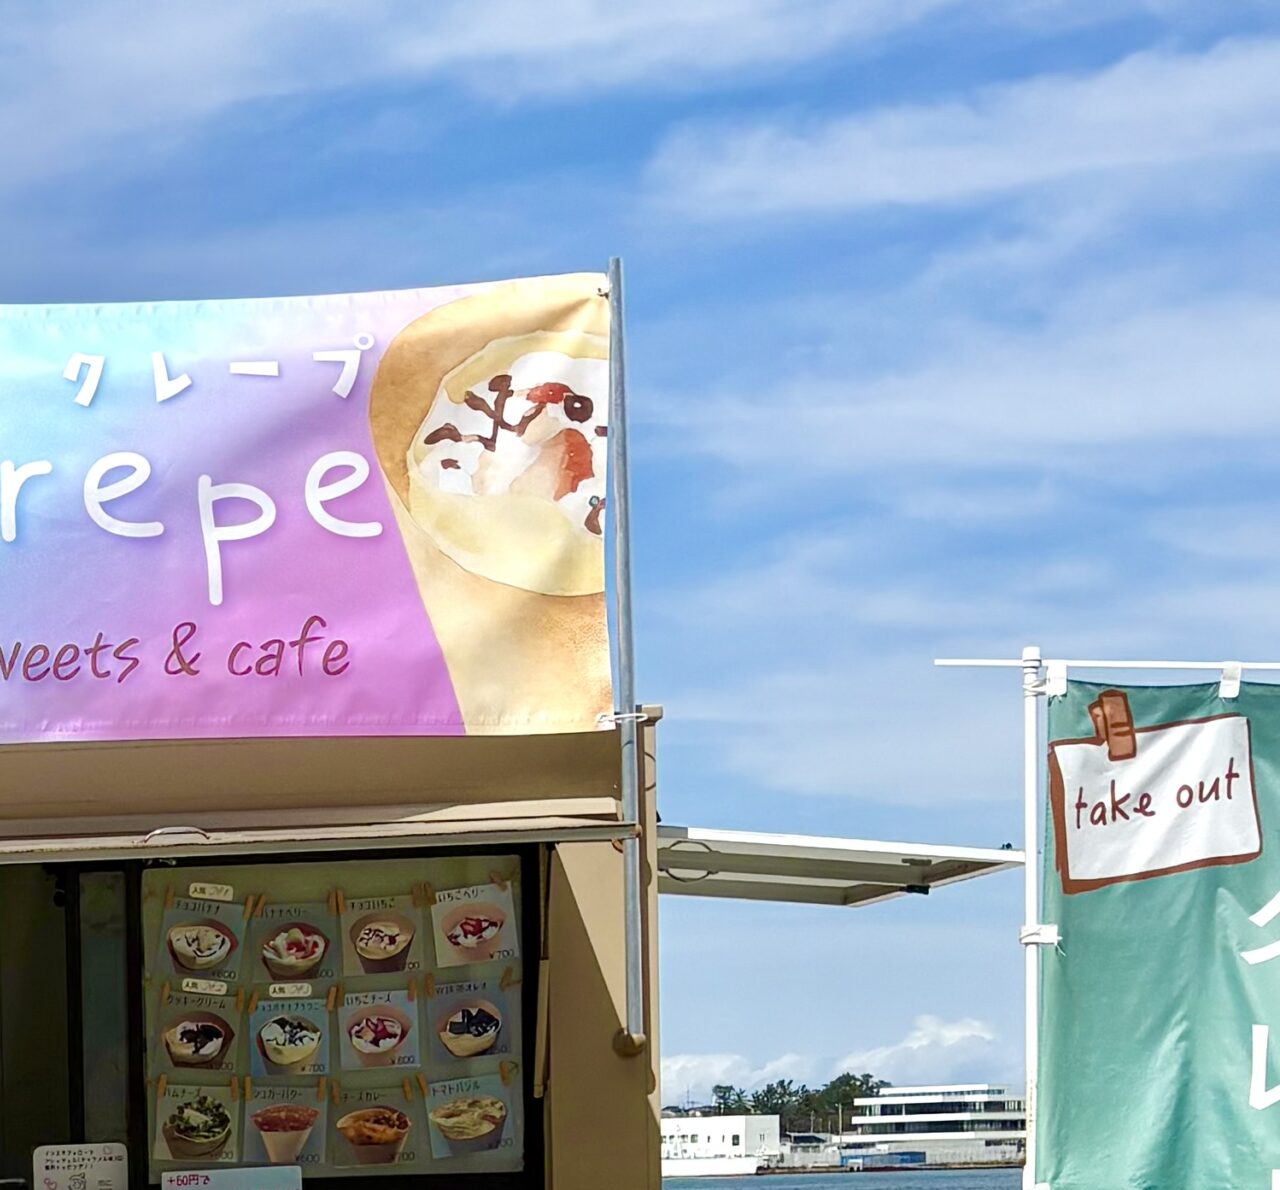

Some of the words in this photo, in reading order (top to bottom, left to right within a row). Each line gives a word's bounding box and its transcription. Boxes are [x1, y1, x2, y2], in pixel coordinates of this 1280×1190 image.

[63, 331, 375, 407] クレープ
[164, 621, 201, 677] &
[227, 614, 351, 678] cafe
[1075, 779, 1156, 830] take
[1176, 757, 1240, 809] out
